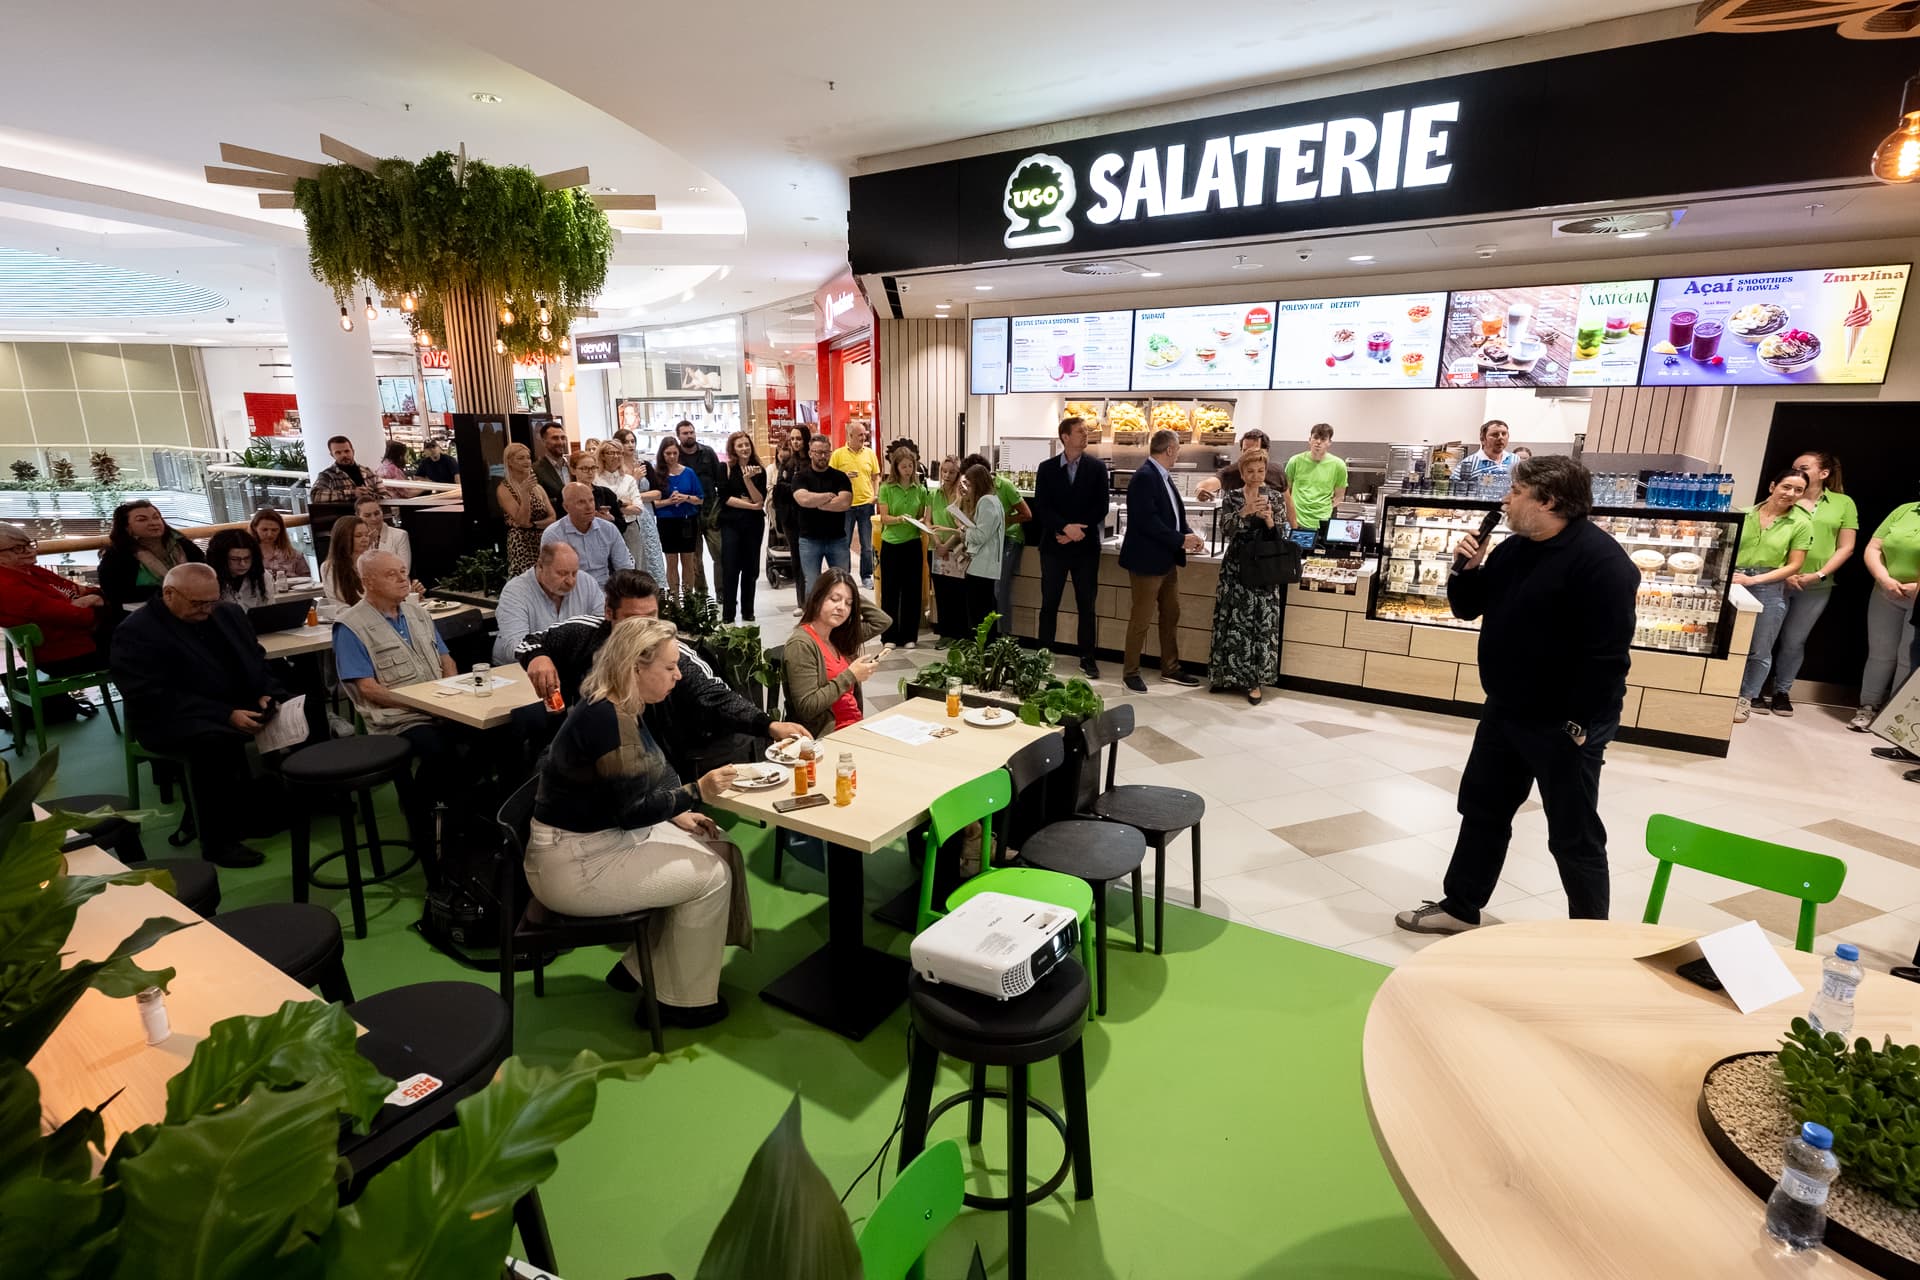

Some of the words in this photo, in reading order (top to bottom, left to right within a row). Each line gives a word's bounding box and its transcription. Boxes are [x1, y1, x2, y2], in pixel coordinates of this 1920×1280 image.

[1086, 101, 1460, 224] SALATERIE
[1010, 184, 1059, 208] UGO
[1738, 276, 1793, 285] SMOOTHIES
[1746, 284, 1780, 292] BOWLS
[1589, 292, 1649, 306] MATCHA
